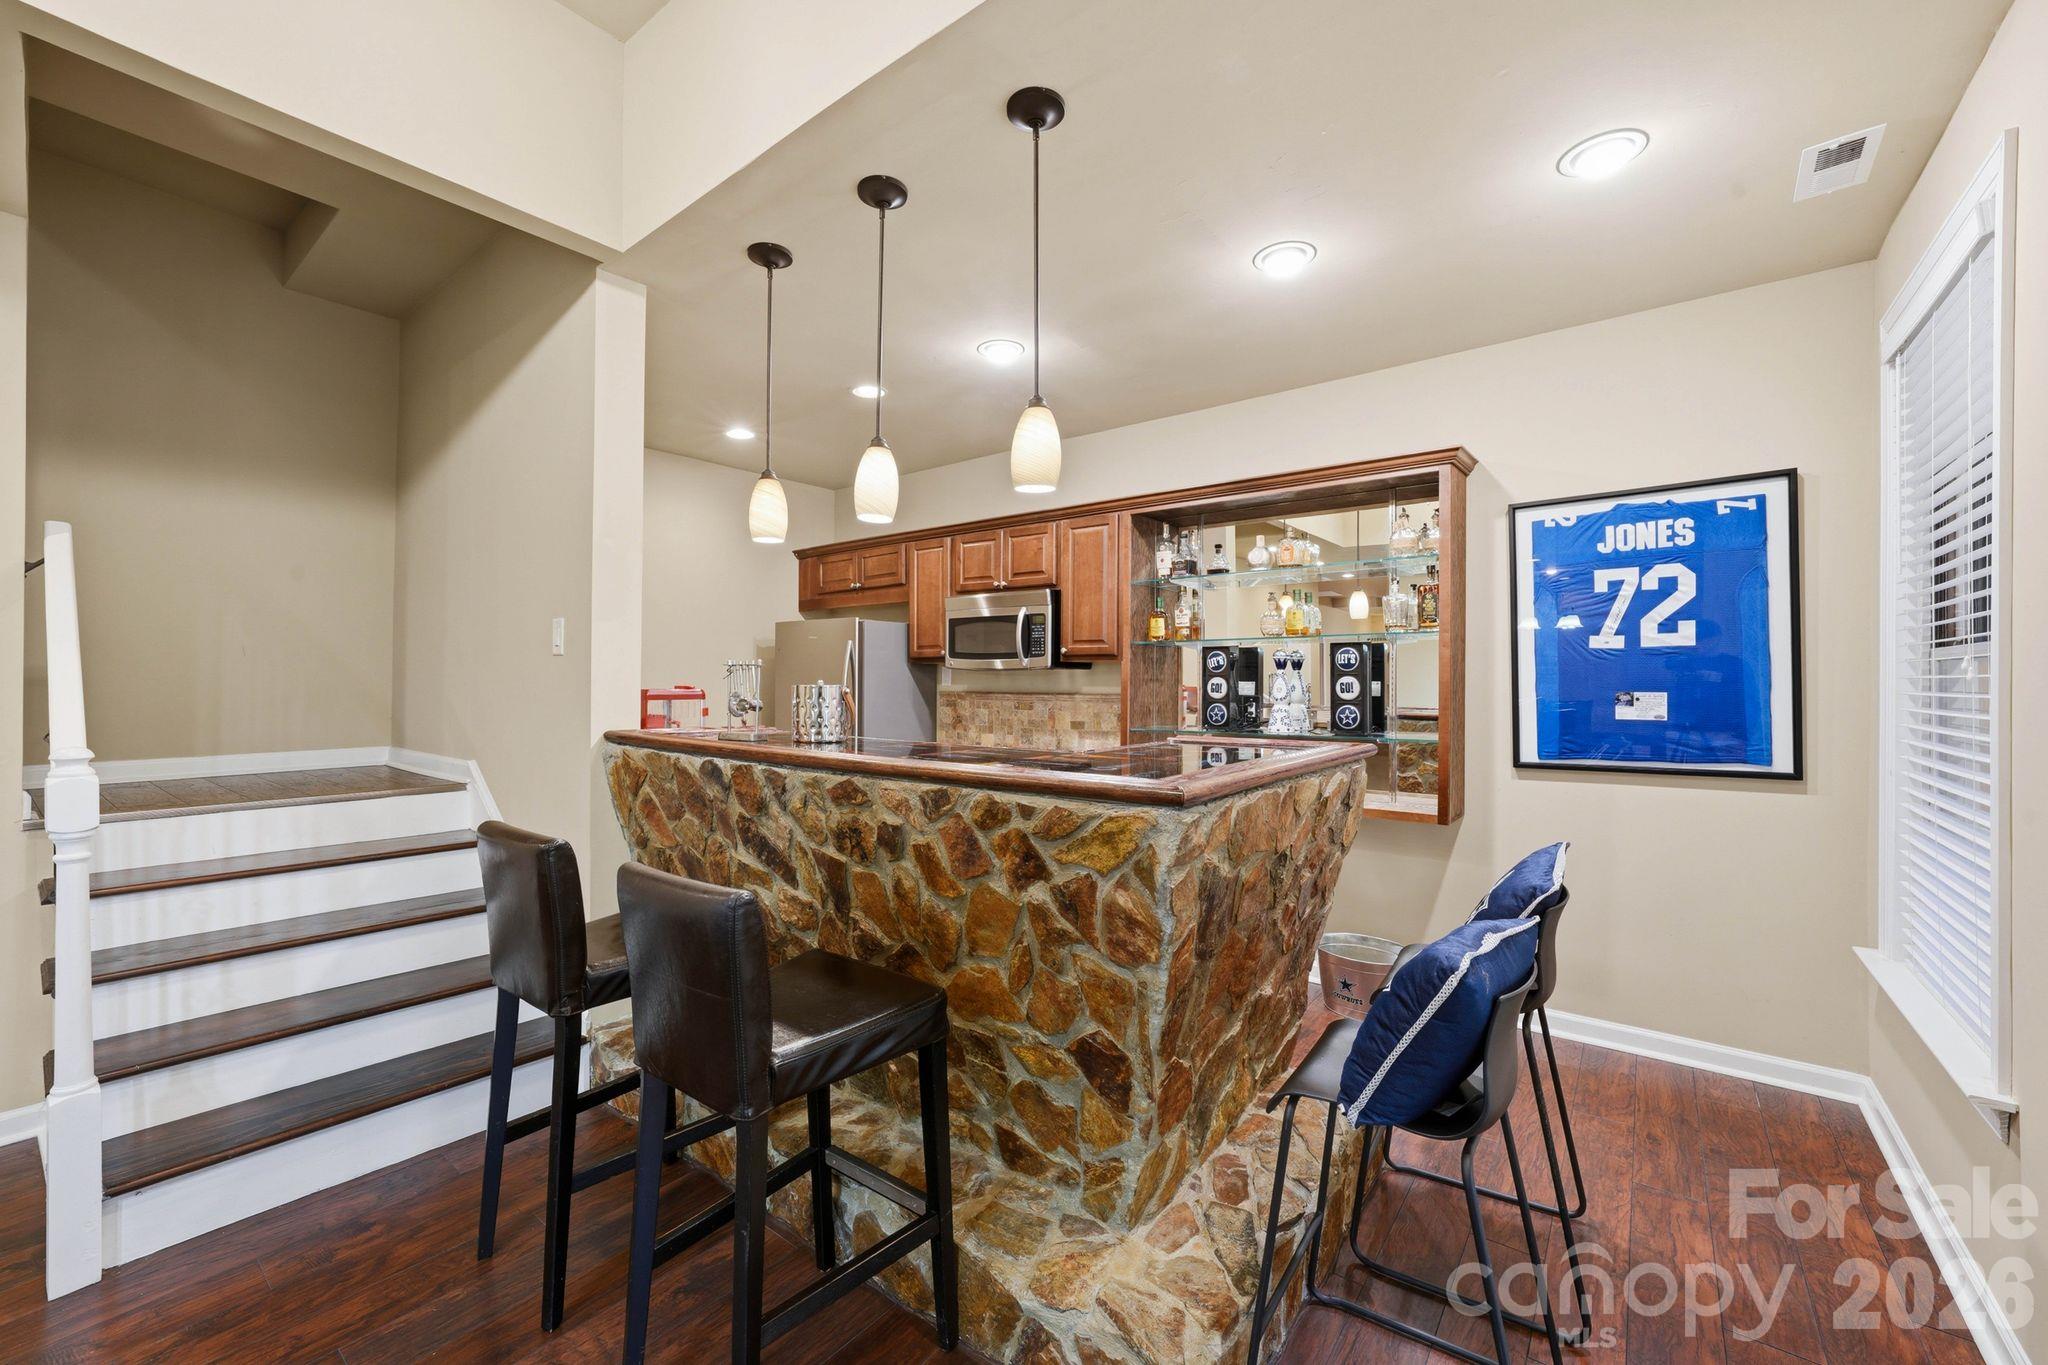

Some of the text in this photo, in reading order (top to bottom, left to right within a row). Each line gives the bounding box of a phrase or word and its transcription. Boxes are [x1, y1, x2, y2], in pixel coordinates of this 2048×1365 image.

[1597, 517, 1695, 554] JONES
[1588, 563, 1696, 649] 72
[1208, 655, 1224, 668] LET'S
[1337, 653, 1356, 664] LET'S
[1210, 683, 1223, 694] GO!
[1340, 682, 1354, 693] GO!
